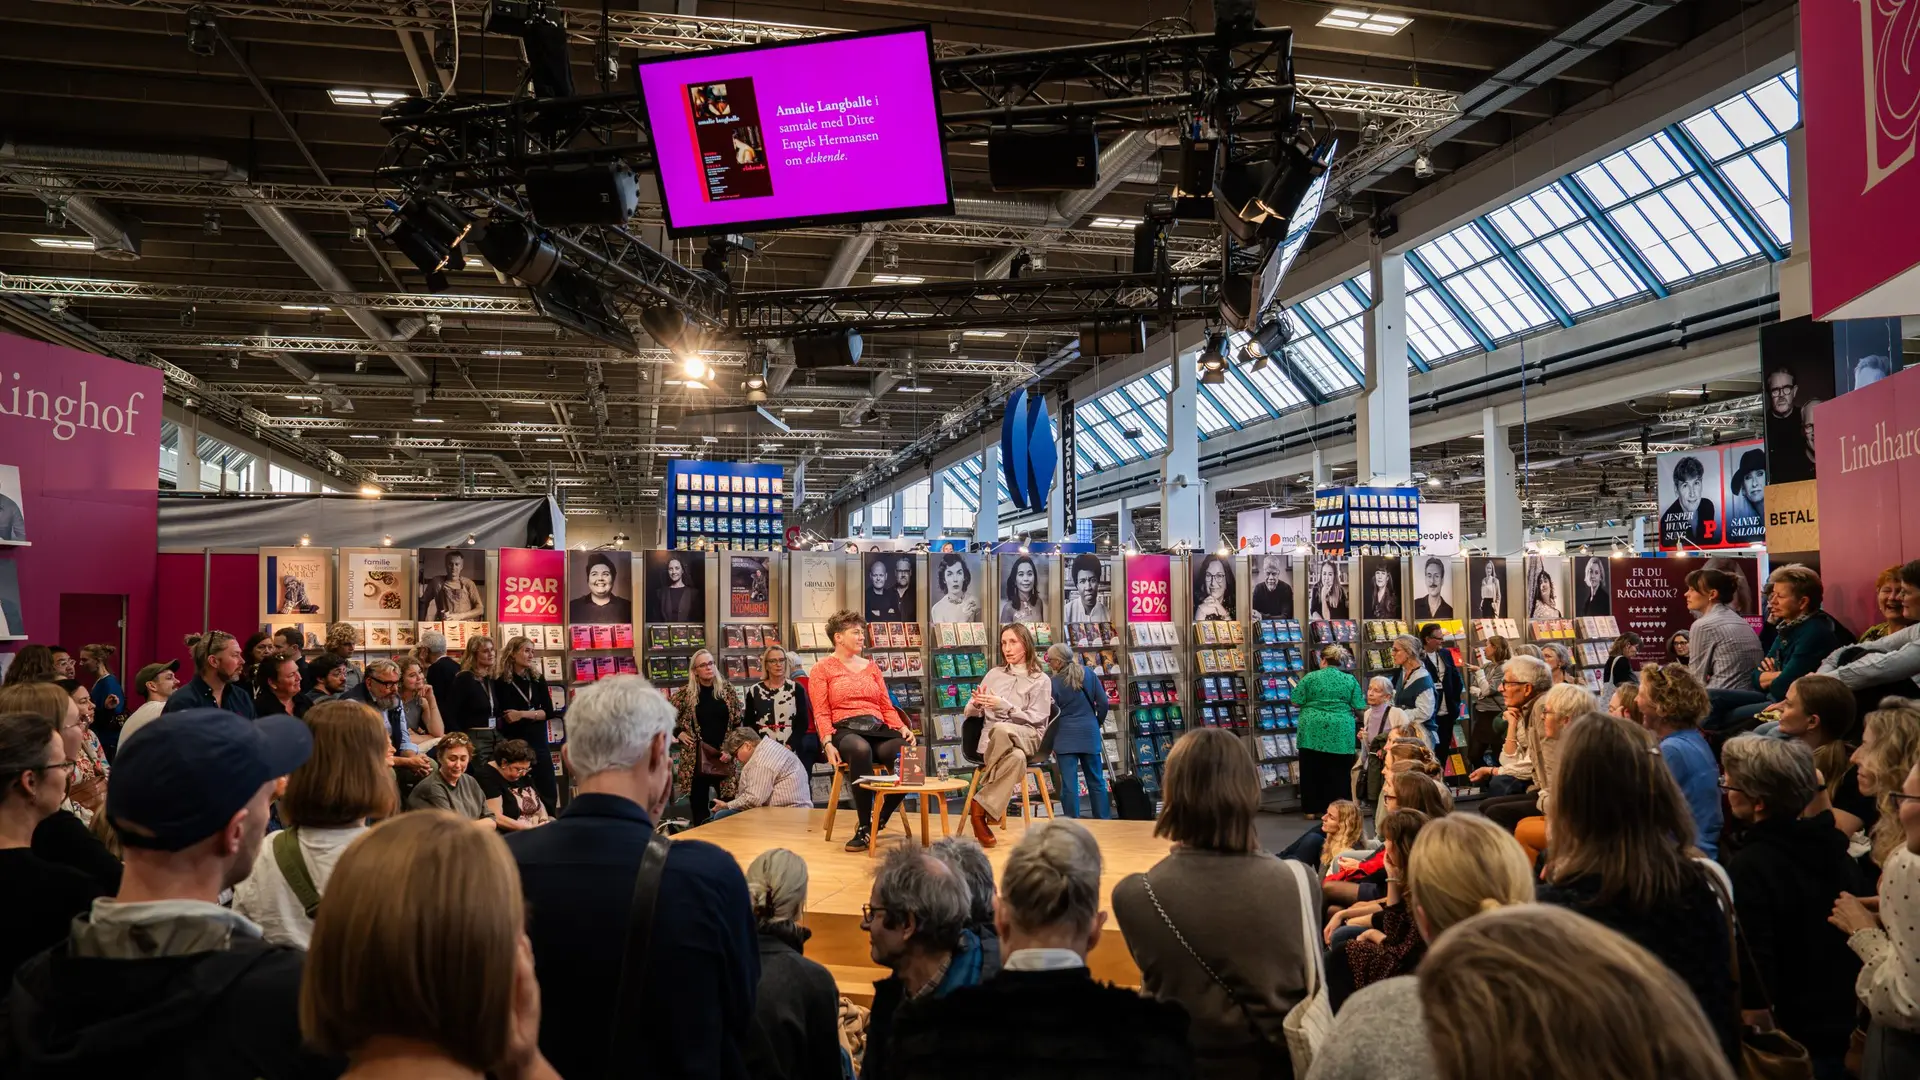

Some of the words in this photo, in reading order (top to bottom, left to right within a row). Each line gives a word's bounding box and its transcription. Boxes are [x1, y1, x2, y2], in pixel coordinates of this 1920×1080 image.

[776, 102, 815, 116] Amalie
[817, 95, 873, 113] Langballe
[875, 95, 879, 106] i
[779, 118, 818, 133] samtale
[820, 115, 844, 129] med
[846, 113, 875, 127] Ditte
[781, 135, 816, 152] Engels
[818, 131, 879, 147] Hermansen
[785, 156, 803, 167] om
[805, 149, 848, 164] elskende.
[0, 371, 145, 441] inghof
[1065, 437, 1074, 528] Modtryk
[1664, 511, 1694, 523] JESPER
[1731, 515, 1760, 527] SANNE
[1769, 509, 1815, 526] BETAL
[1666, 521, 1692, 531] WUNG-
[1665, 531, 1687, 540] SUNG
[364, 558, 391, 566] familie
[1632, 567, 1645, 577] ER
[1647, 567, 1662, 577] DU
[504, 576, 558, 594] SPAR
[1131, 580, 1167, 595] SPAR
[1626, 578, 1652, 588] KLAR
[1653, 578, 1669, 588] TIL
[1617, 587, 1678, 599] RAGNAROK?
[504, 594, 558, 614] 20%
[1131, 596, 1167, 614] 20%
